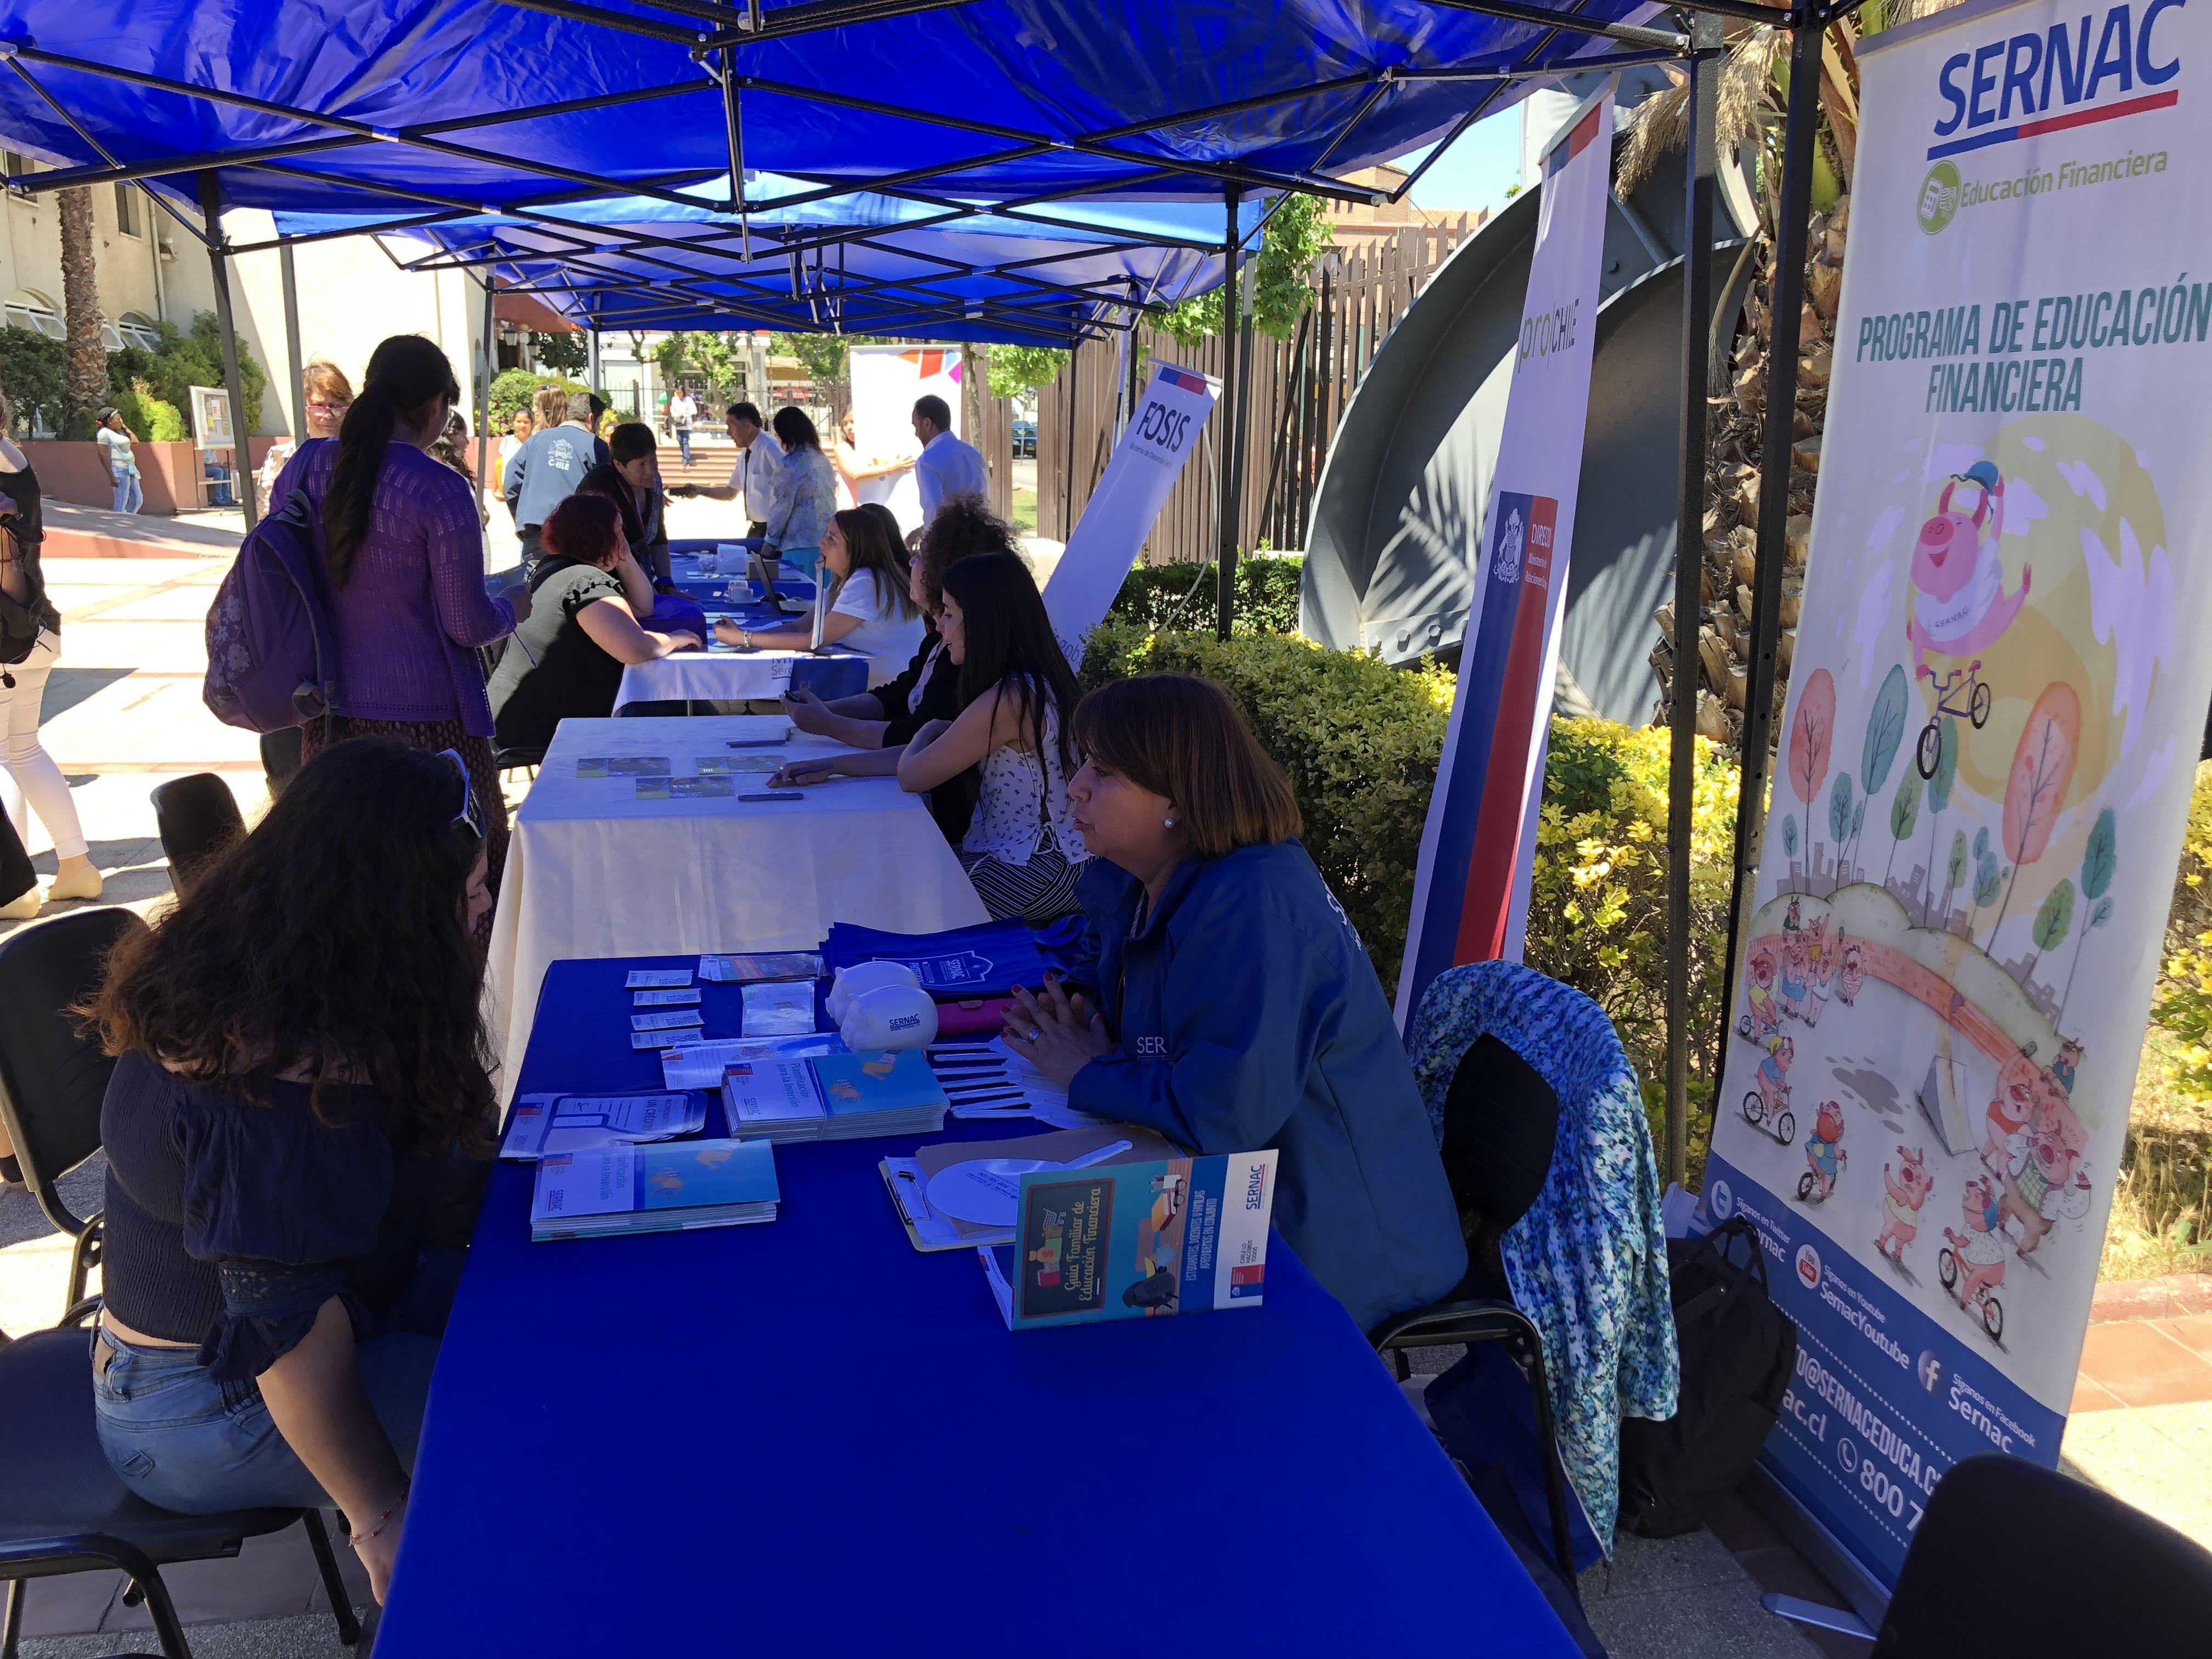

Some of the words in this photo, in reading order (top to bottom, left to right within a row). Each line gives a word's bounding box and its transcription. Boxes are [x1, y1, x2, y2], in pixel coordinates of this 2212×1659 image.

[1933, 0, 2185, 137] SERNAC
[1960, 168, 2053, 208] Educación
[2057, 149, 2169, 190] Financiera
[1857, 304, 1981, 363] PROGRAMA
[1988, 300, 2029, 354] DE
[2032, 272, 2212, 353] EDUCACIÓN
[1926, 357, 2084, 413] FINANCIERA
[1136, 400, 1191, 453] FOSIS
[548, 459, 570, 471] CHILE
[1934, 606, 1968, 628] SERNAC
[947, 959, 965, 979] SERNAC
[889, 1013, 920, 1027] SERNAC
[1137, 1036, 1168, 1054] SER
[775, 1064, 788, 1076] para
[783, 1083, 801, 1108] Inversión
[791, 1063, 811, 1098] Planificación
[641, 1109, 657, 1131] CRÉDITO
[646, 1099, 658, 1108] UN
[600, 1172, 614, 1200] Inversión
[616, 1151, 630, 1189] Planificación
[1246, 1164, 1262, 1210] SERNAC
[550, 1189, 564, 1211] SERNAC
[1071, 1201, 1085, 1215] de
[1083, 1187, 1101, 1244] Financiera
[1066, 1216, 1083, 1262] Familiar
[1760, 1216, 1769, 1226] en
[1769, 1218, 1791, 1244] Twitter
[1079, 1246, 1096, 1301] Educación
[1801, 1261, 1815, 1279] Tube
[1805, 1248, 1815, 1264] You
[1064, 1264, 1081, 1290] Guía
[1847, 1285, 1857, 1299] en
[1856, 1289, 1886, 1324] Youtube
[1820, 1281, 1910, 1369] SernacYoutube
[1796, 1344, 1943, 1497] O@SERNACEDUCA.C
[1948, 1386, 2013, 1454] Sernac
[1985, 1399, 1996, 1414] en
[1995, 1406, 2036, 1447] Facebook
[1860, 1459, 1903, 1517] 800
[1906, 1499, 1925, 1531] 7
